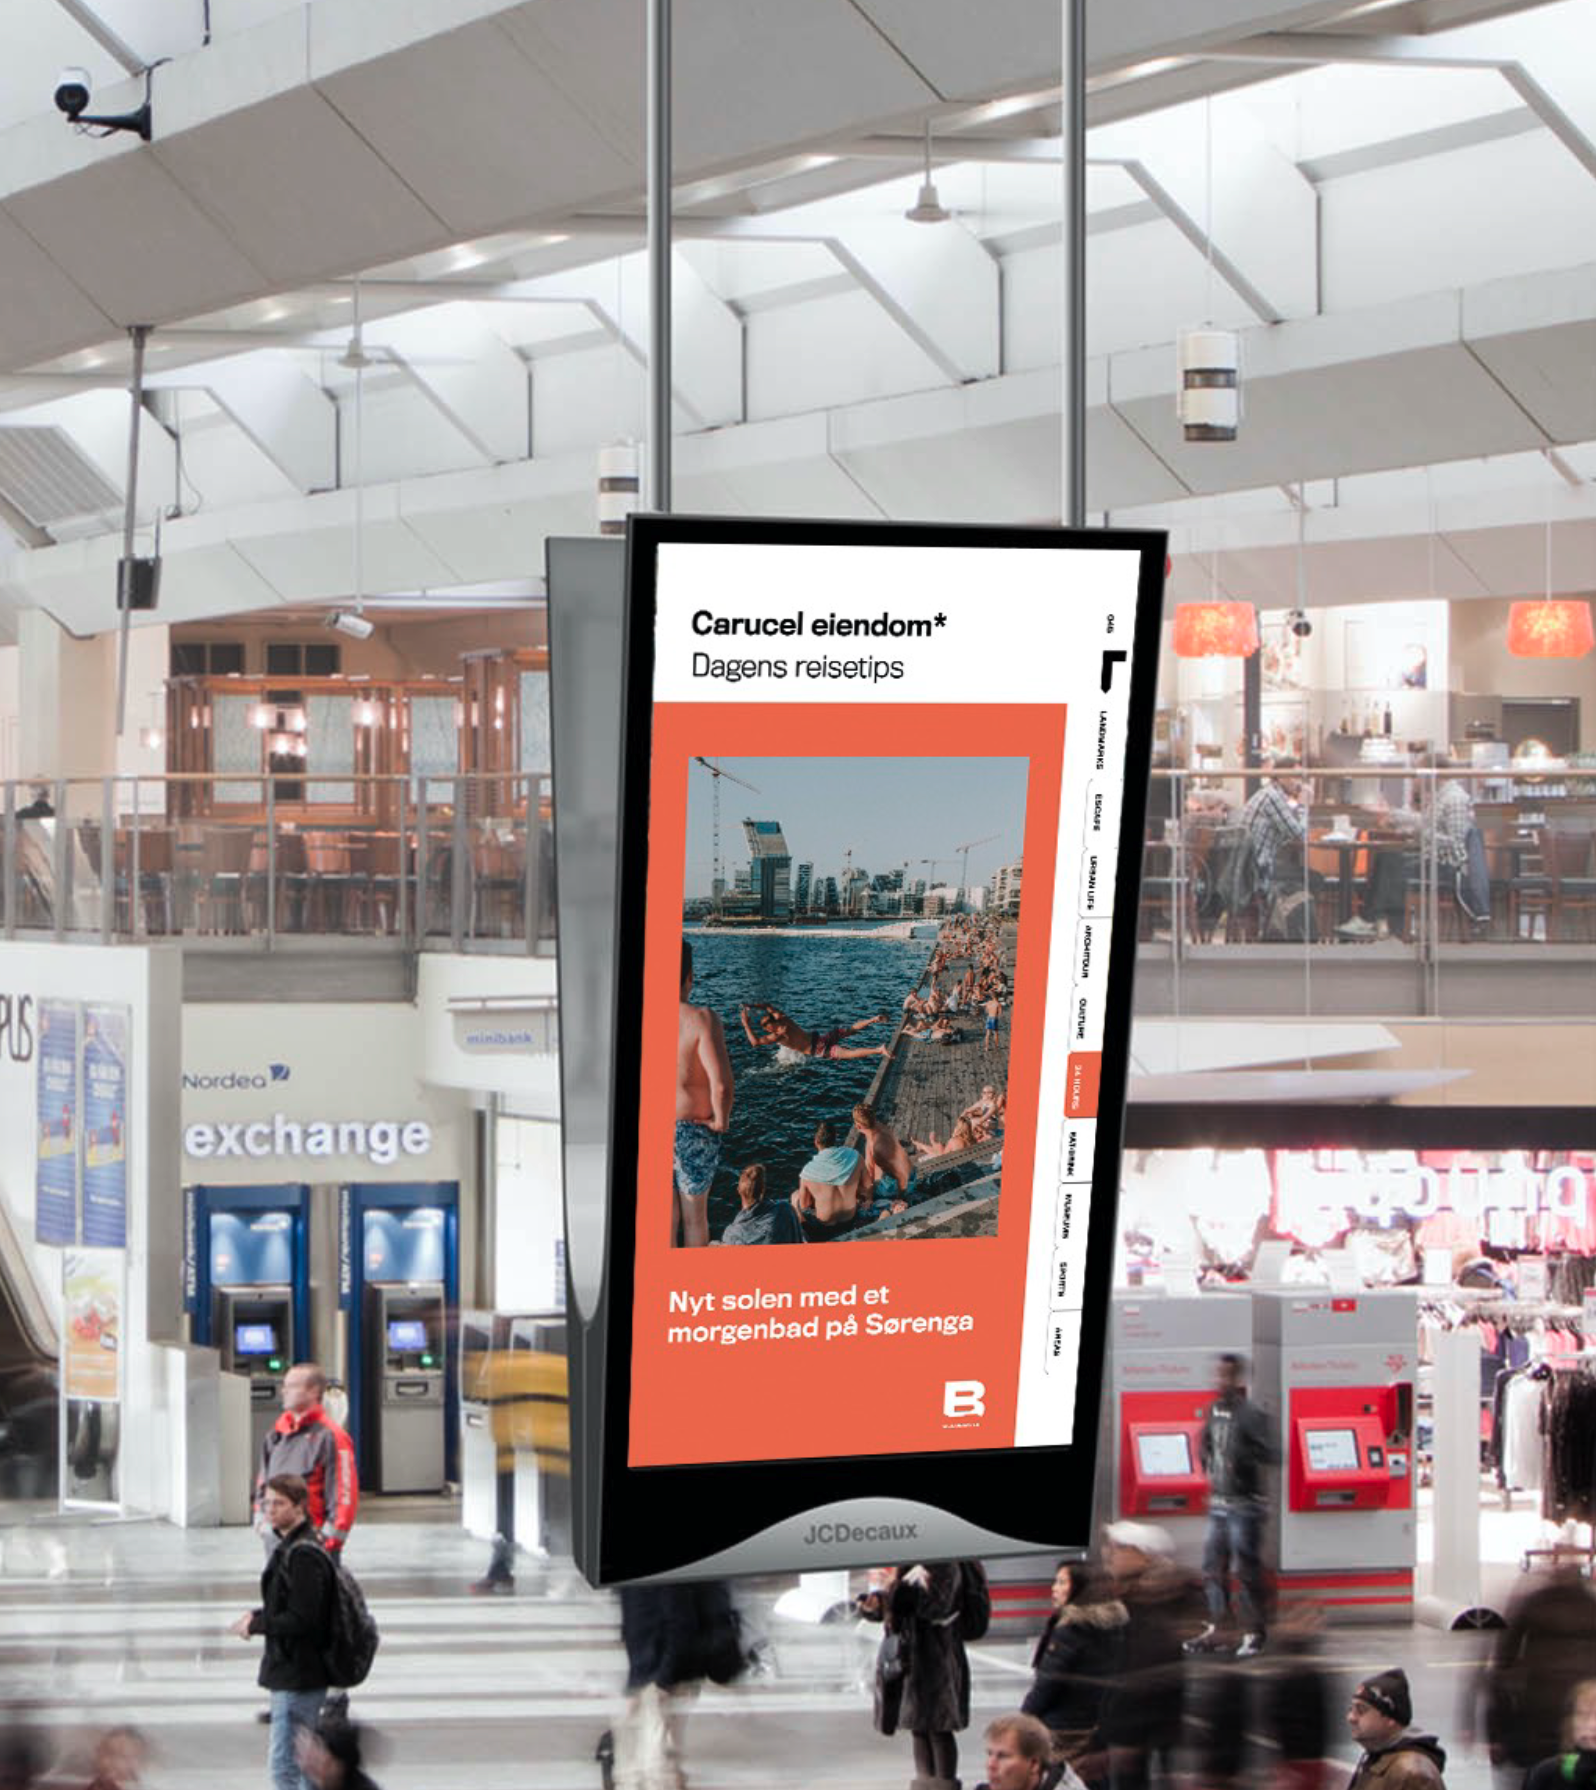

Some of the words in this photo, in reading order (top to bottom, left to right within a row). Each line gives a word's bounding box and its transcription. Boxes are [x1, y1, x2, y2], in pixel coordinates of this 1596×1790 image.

[691, 610, 804, 636] Carucel
[692, 651, 788, 683] Dagens
[795, 655, 904, 684] reisetips
[466, 1030, 532, 1045] minibank
[182, 1073, 267, 1089] Nordea
[185, 1113, 432, 1165] exchange
[668, 1291, 715, 1317] Nyt
[722, 1288, 792, 1311] solen
[799, 1284, 857, 1308] med
[863, 1285, 890, 1306] et
[667, 1316, 819, 1345] morgenbad
[825, 1314, 859, 1341] på
[865, 1312, 974, 1336] Sørenga
[943, 1380, 986, 1417] B
[803, 1523, 918, 1545] JCDecaux
